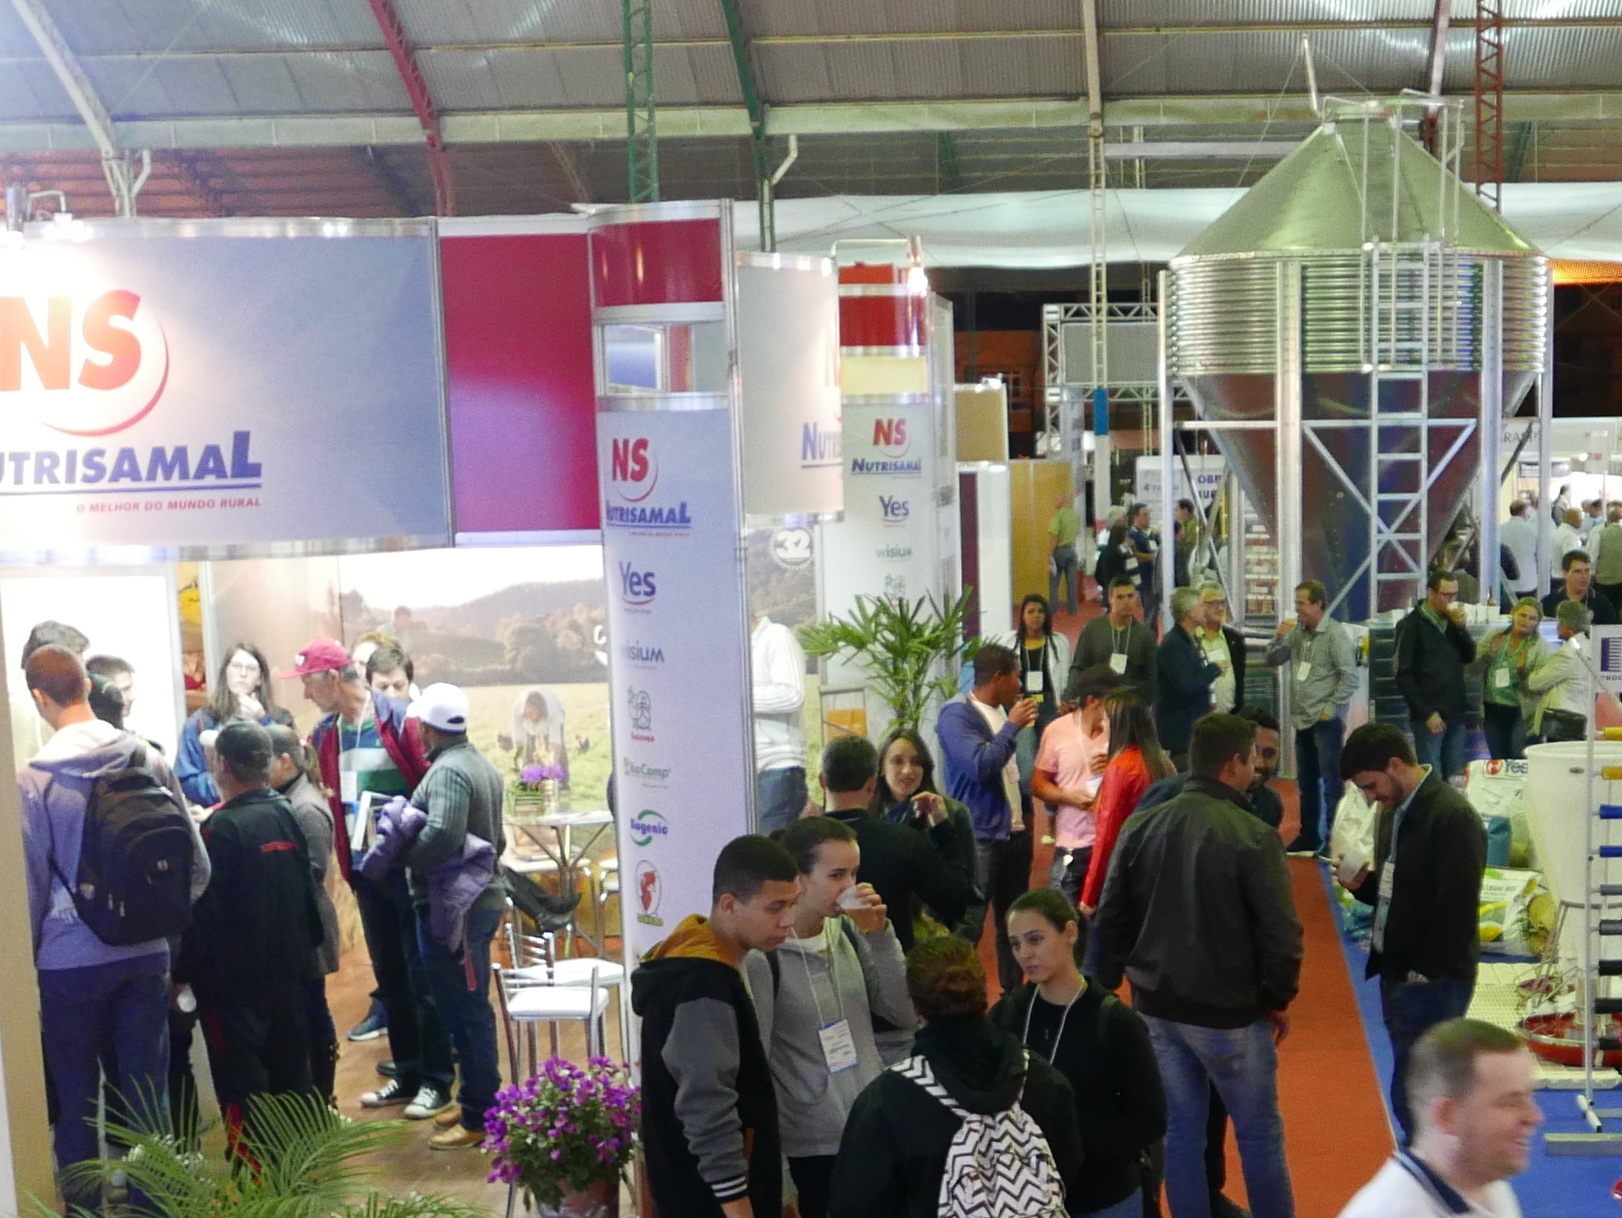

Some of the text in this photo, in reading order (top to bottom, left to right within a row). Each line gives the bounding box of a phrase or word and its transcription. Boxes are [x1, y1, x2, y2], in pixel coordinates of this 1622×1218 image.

[0, 288, 141, 392] NS
[873, 418, 906, 446] NS
[611, 437, 650, 482] NS
[89, 501, 140, 512] MELHOR
[168, 497, 216, 510] MUNDO
[879, 495, 909, 518] Yes
[776, 529, 811, 558] 32
[619, 560, 656, 597] Yes
